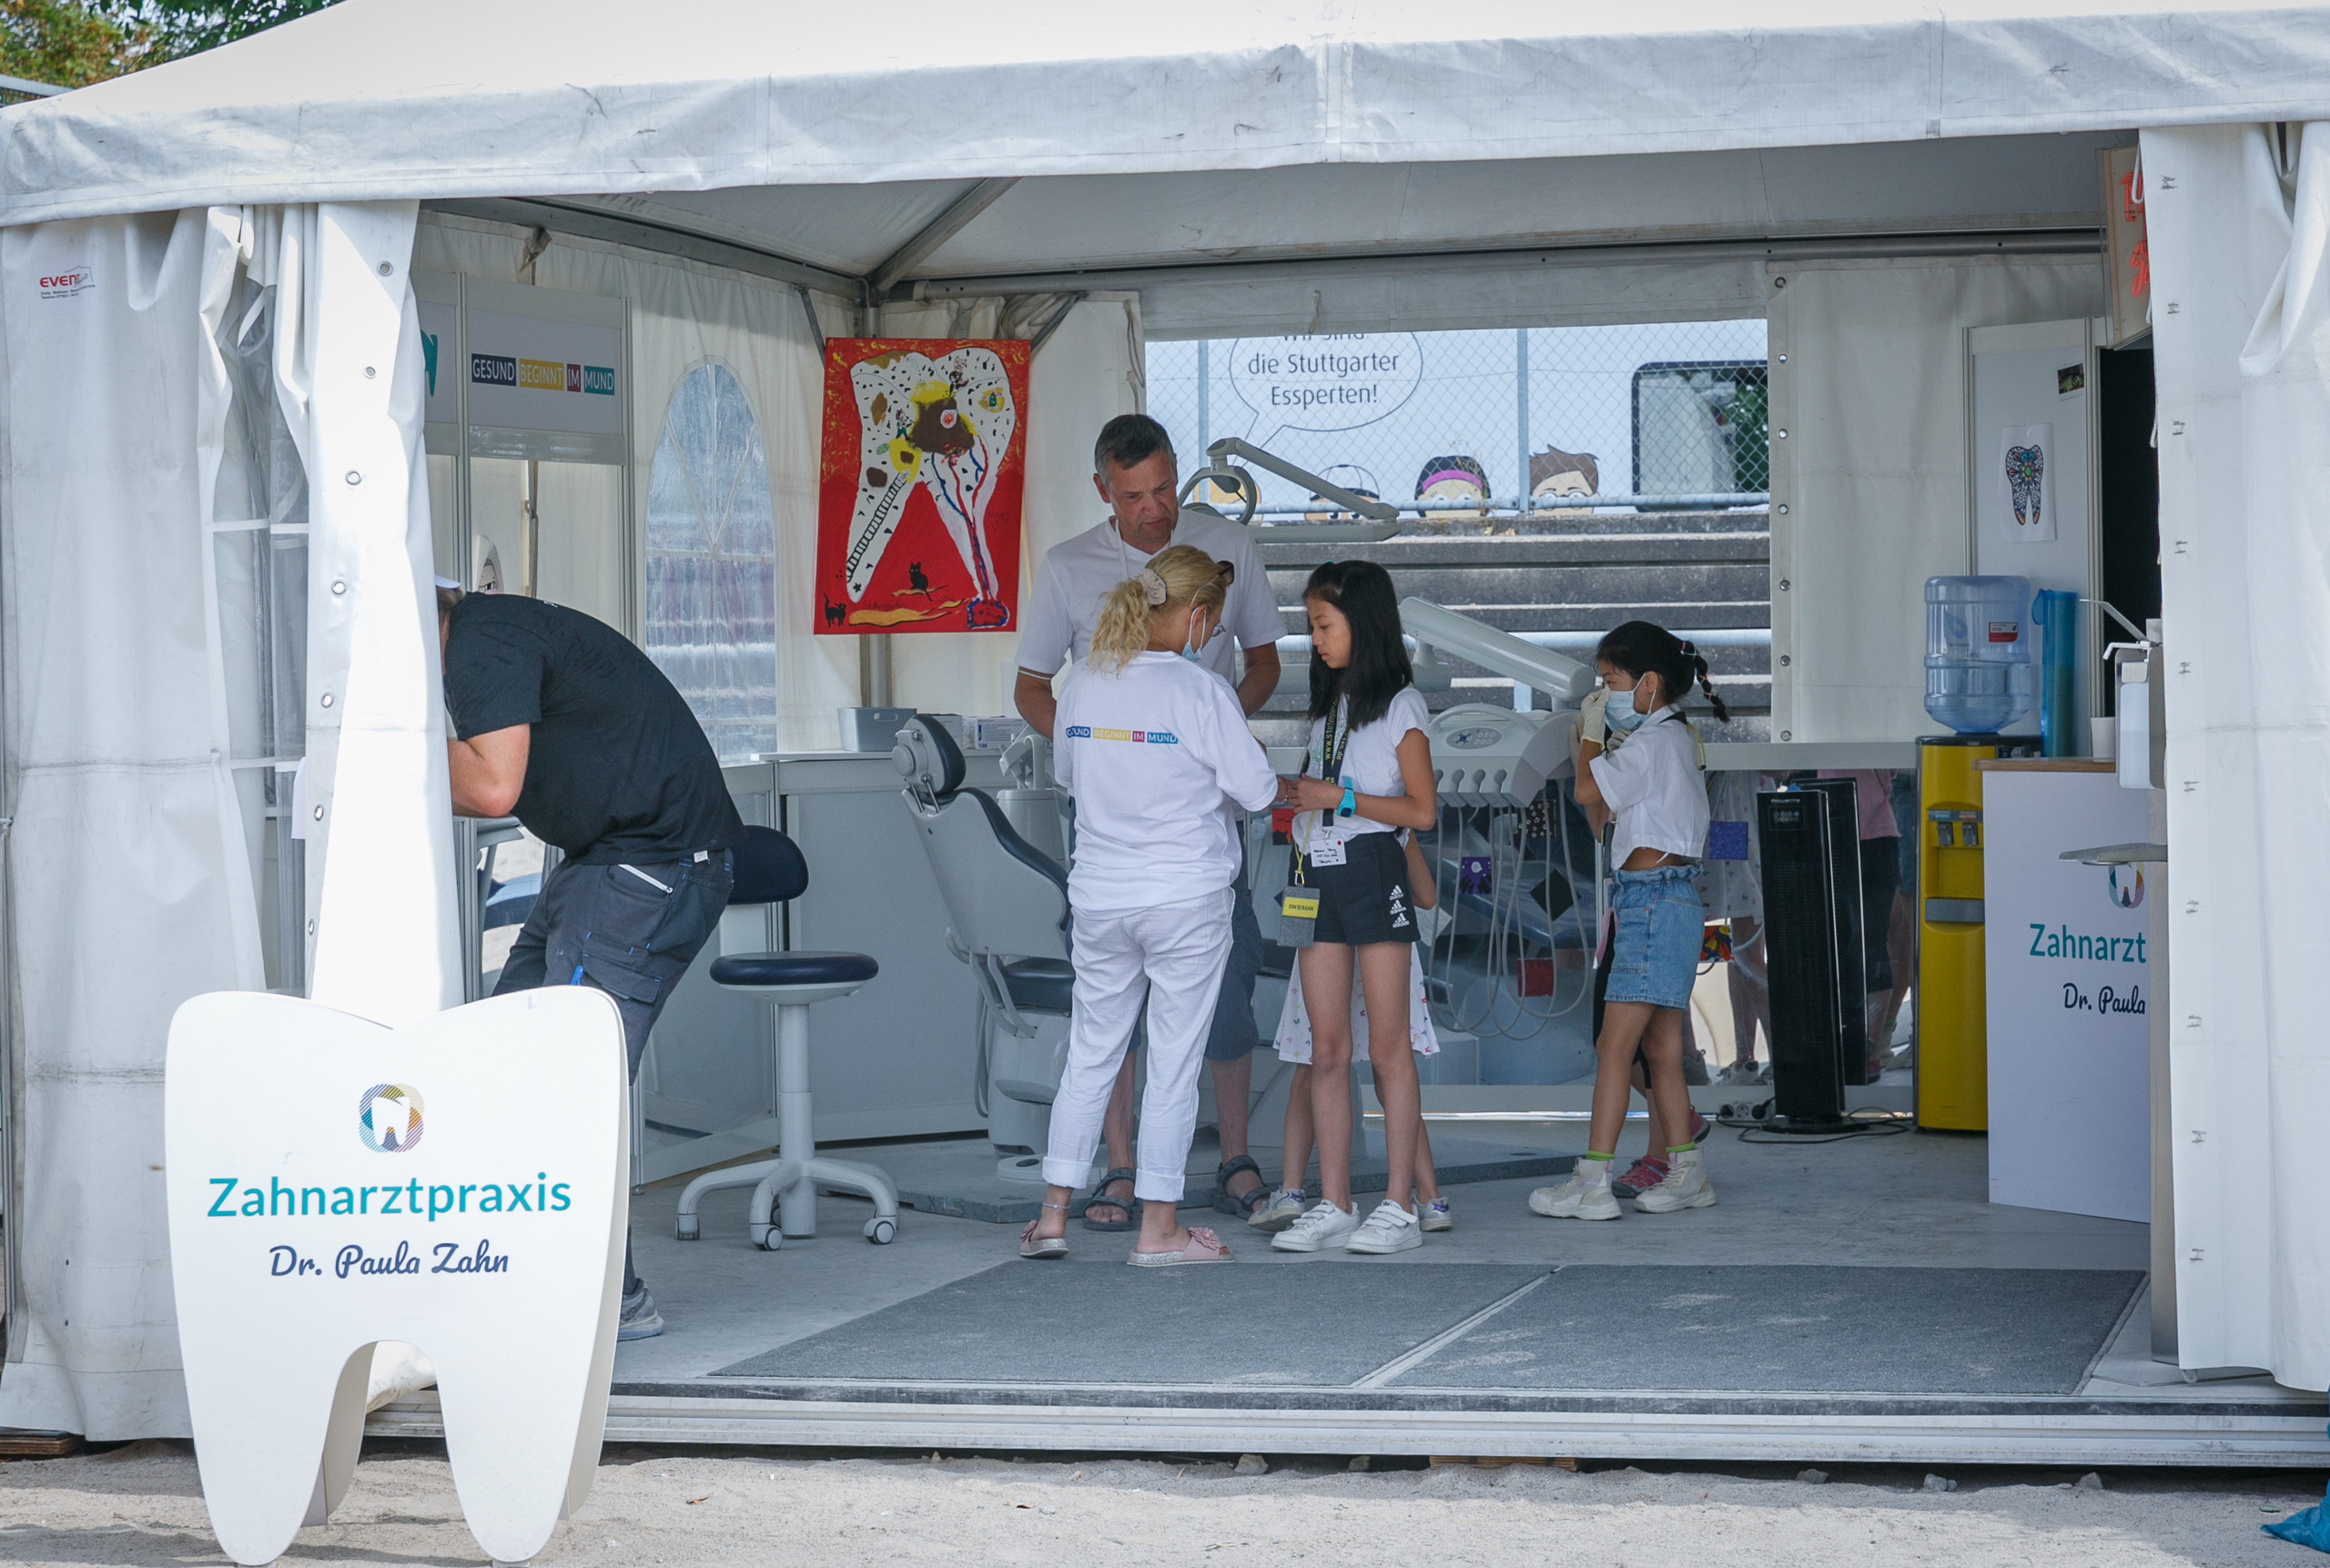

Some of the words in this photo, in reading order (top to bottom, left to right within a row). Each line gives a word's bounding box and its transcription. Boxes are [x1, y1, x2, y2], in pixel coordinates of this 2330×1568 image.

[472, 359, 515, 380] GESUND
[520, 363, 562, 386] BEGINNT
[568, 368, 580, 387] IM
[584, 370, 614, 390] MUND
[1248, 352, 1279, 375] die
[1288, 352, 1399, 378] Stuttgarter
[1271, 384, 1377, 410] Essperten!
[1094, 729, 1130, 740] BEGINNT
[1133, 732, 1144, 741] IM
[1148, 733, 1177, 743] MUND
[2030, 923, 2146, 964] Zahnarzt
[2062, 982, 2092, 1010] Dr.
[2098, 985, 2145, 1015] Paula
[207, 1171, 572, 1222] Zahnarztpraxis
[268, 1245, 322, 1277] Dr.
[334, 1239, 420, 1279] Paula
[431, 1239, 509, 1273] Zahn
